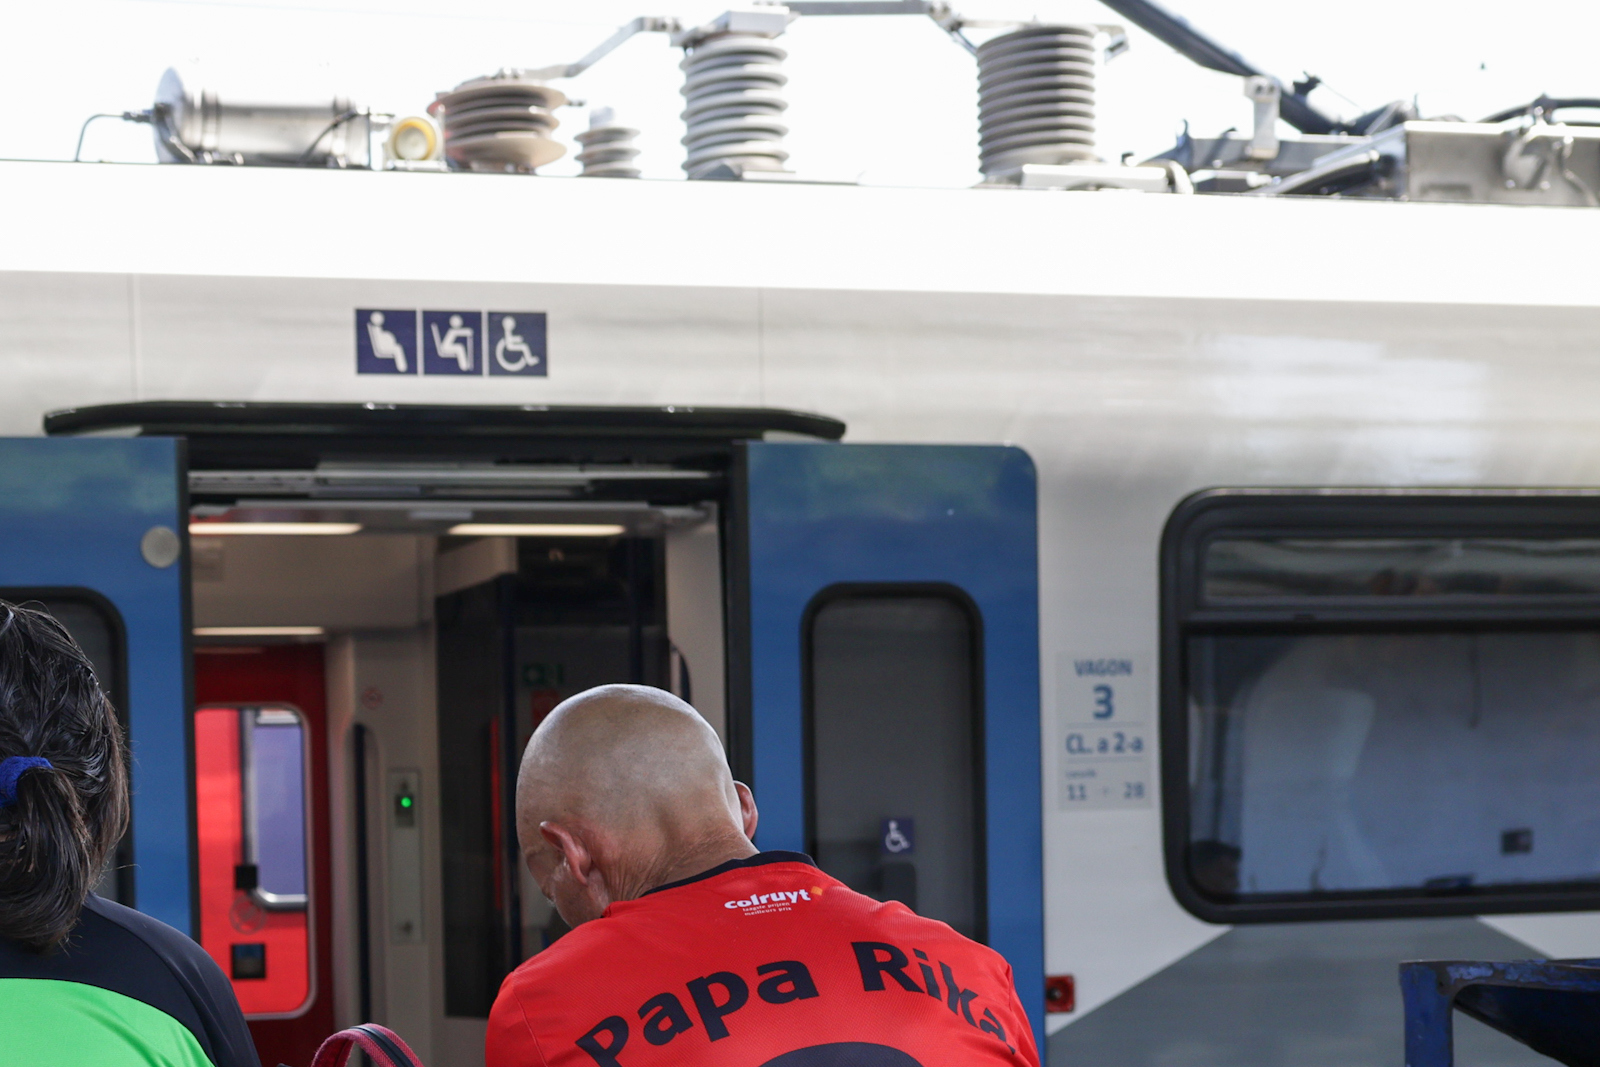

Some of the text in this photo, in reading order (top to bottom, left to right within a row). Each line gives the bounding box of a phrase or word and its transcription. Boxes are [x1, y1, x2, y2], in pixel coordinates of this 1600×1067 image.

[1074, 659, 1133, 677] VAGON
[1093, 684, 1114, 720] 3
[724, 889, 811, 909] colruyt
